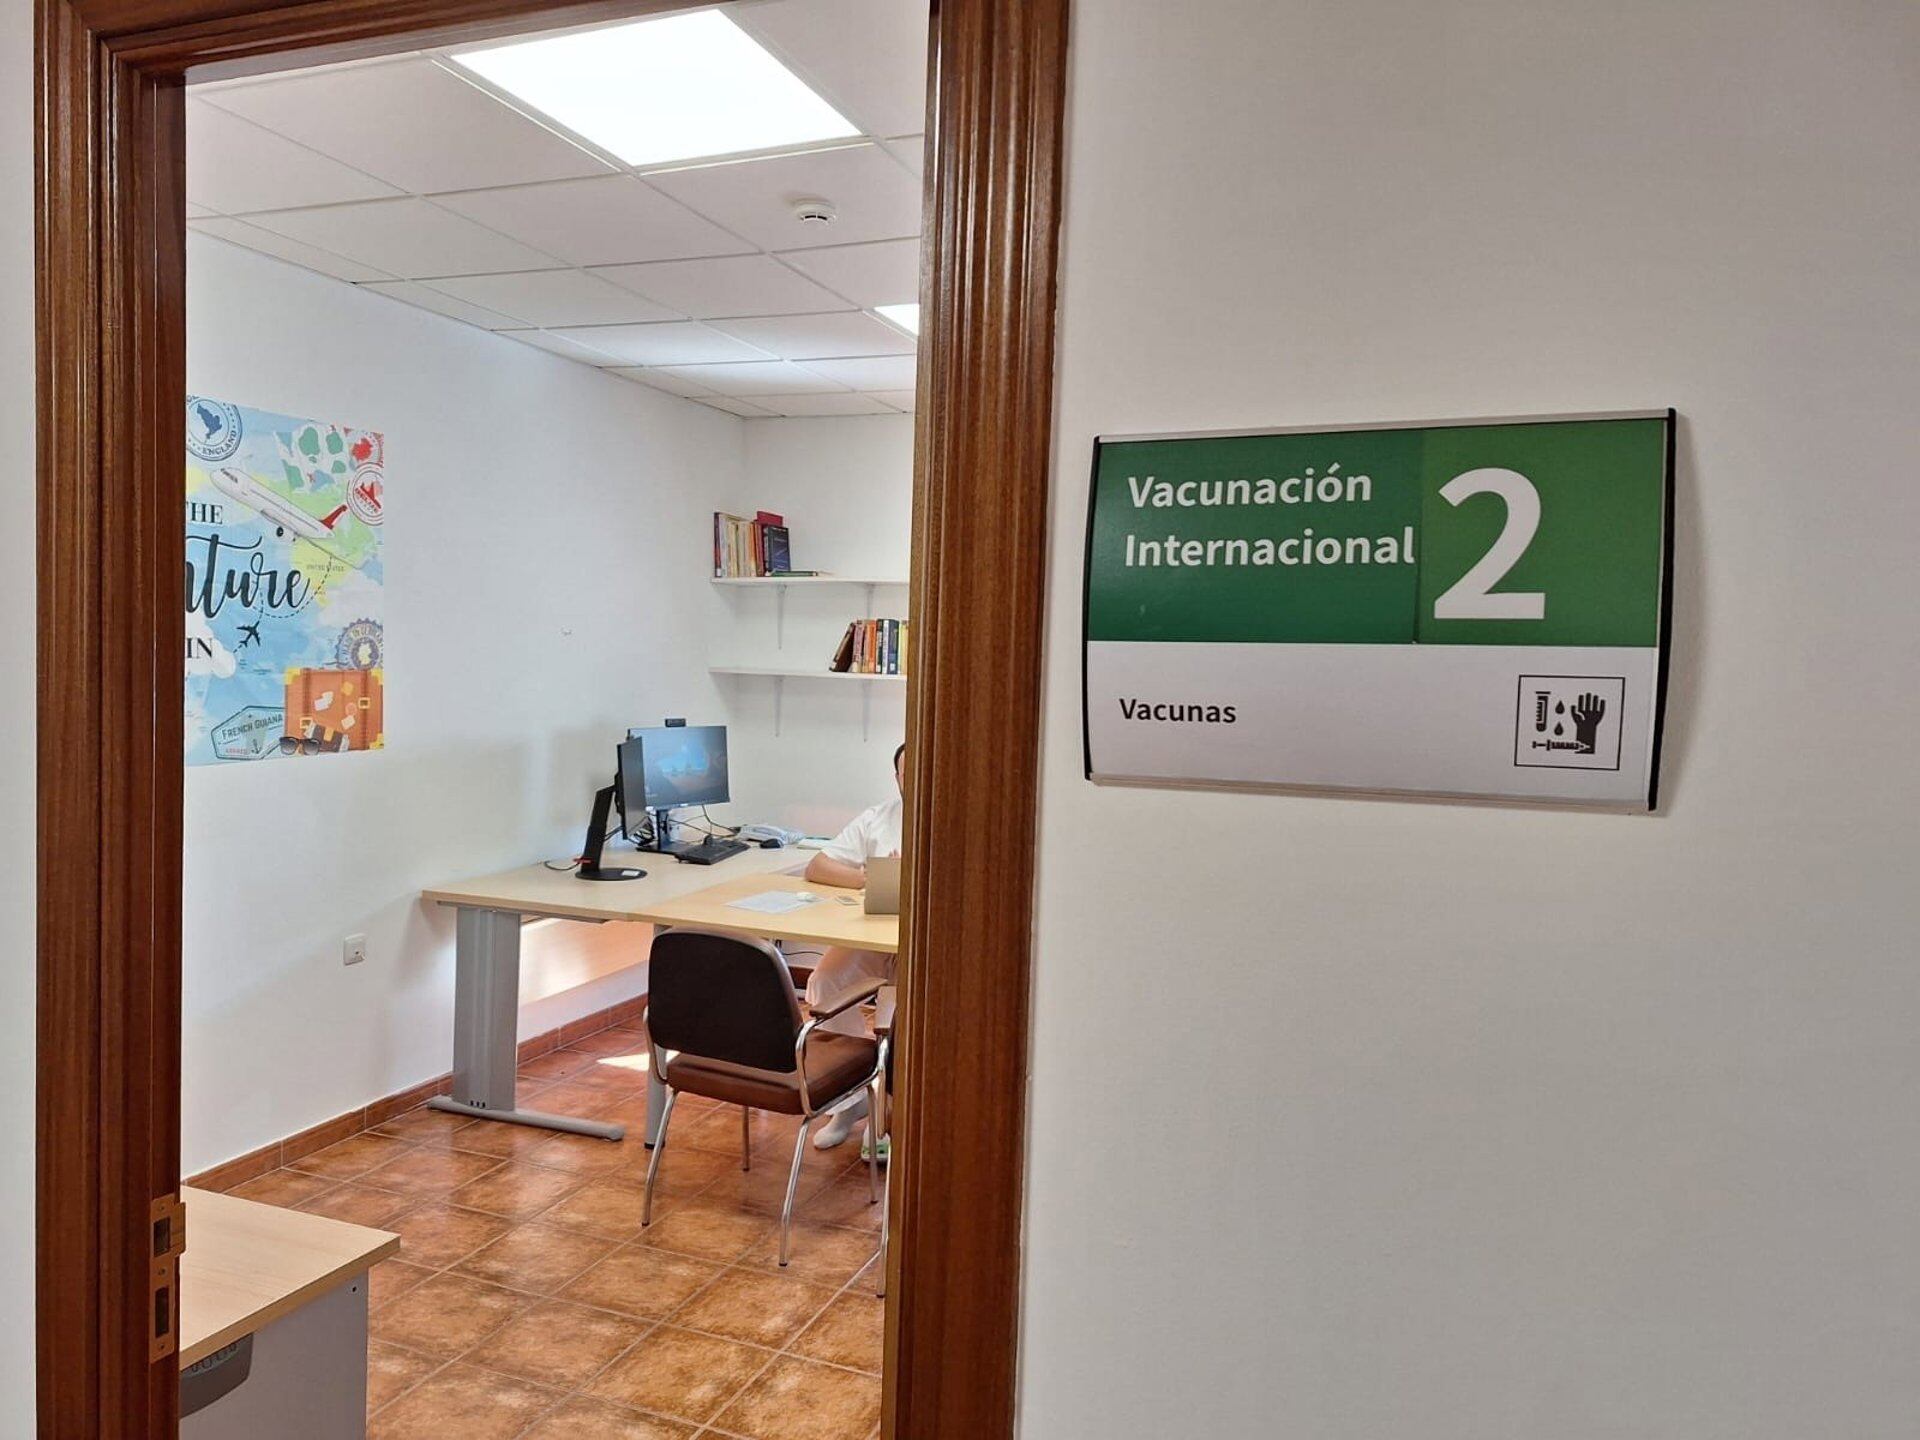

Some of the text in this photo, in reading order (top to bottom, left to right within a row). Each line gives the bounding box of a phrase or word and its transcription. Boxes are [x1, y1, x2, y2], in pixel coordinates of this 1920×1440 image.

[202, 430, 238, 456] ENGLAND
[1128, 463, 1372, 507] Vacunación
[187, 502, 223, 525] HE
[1125, 526, 1415, 567] Internacional
[1432, 467, 1546, 620] 2
[1119, 698, 1237, 724] Vacunas
[221, 713, 284, 740] FRENCH GUIANA
